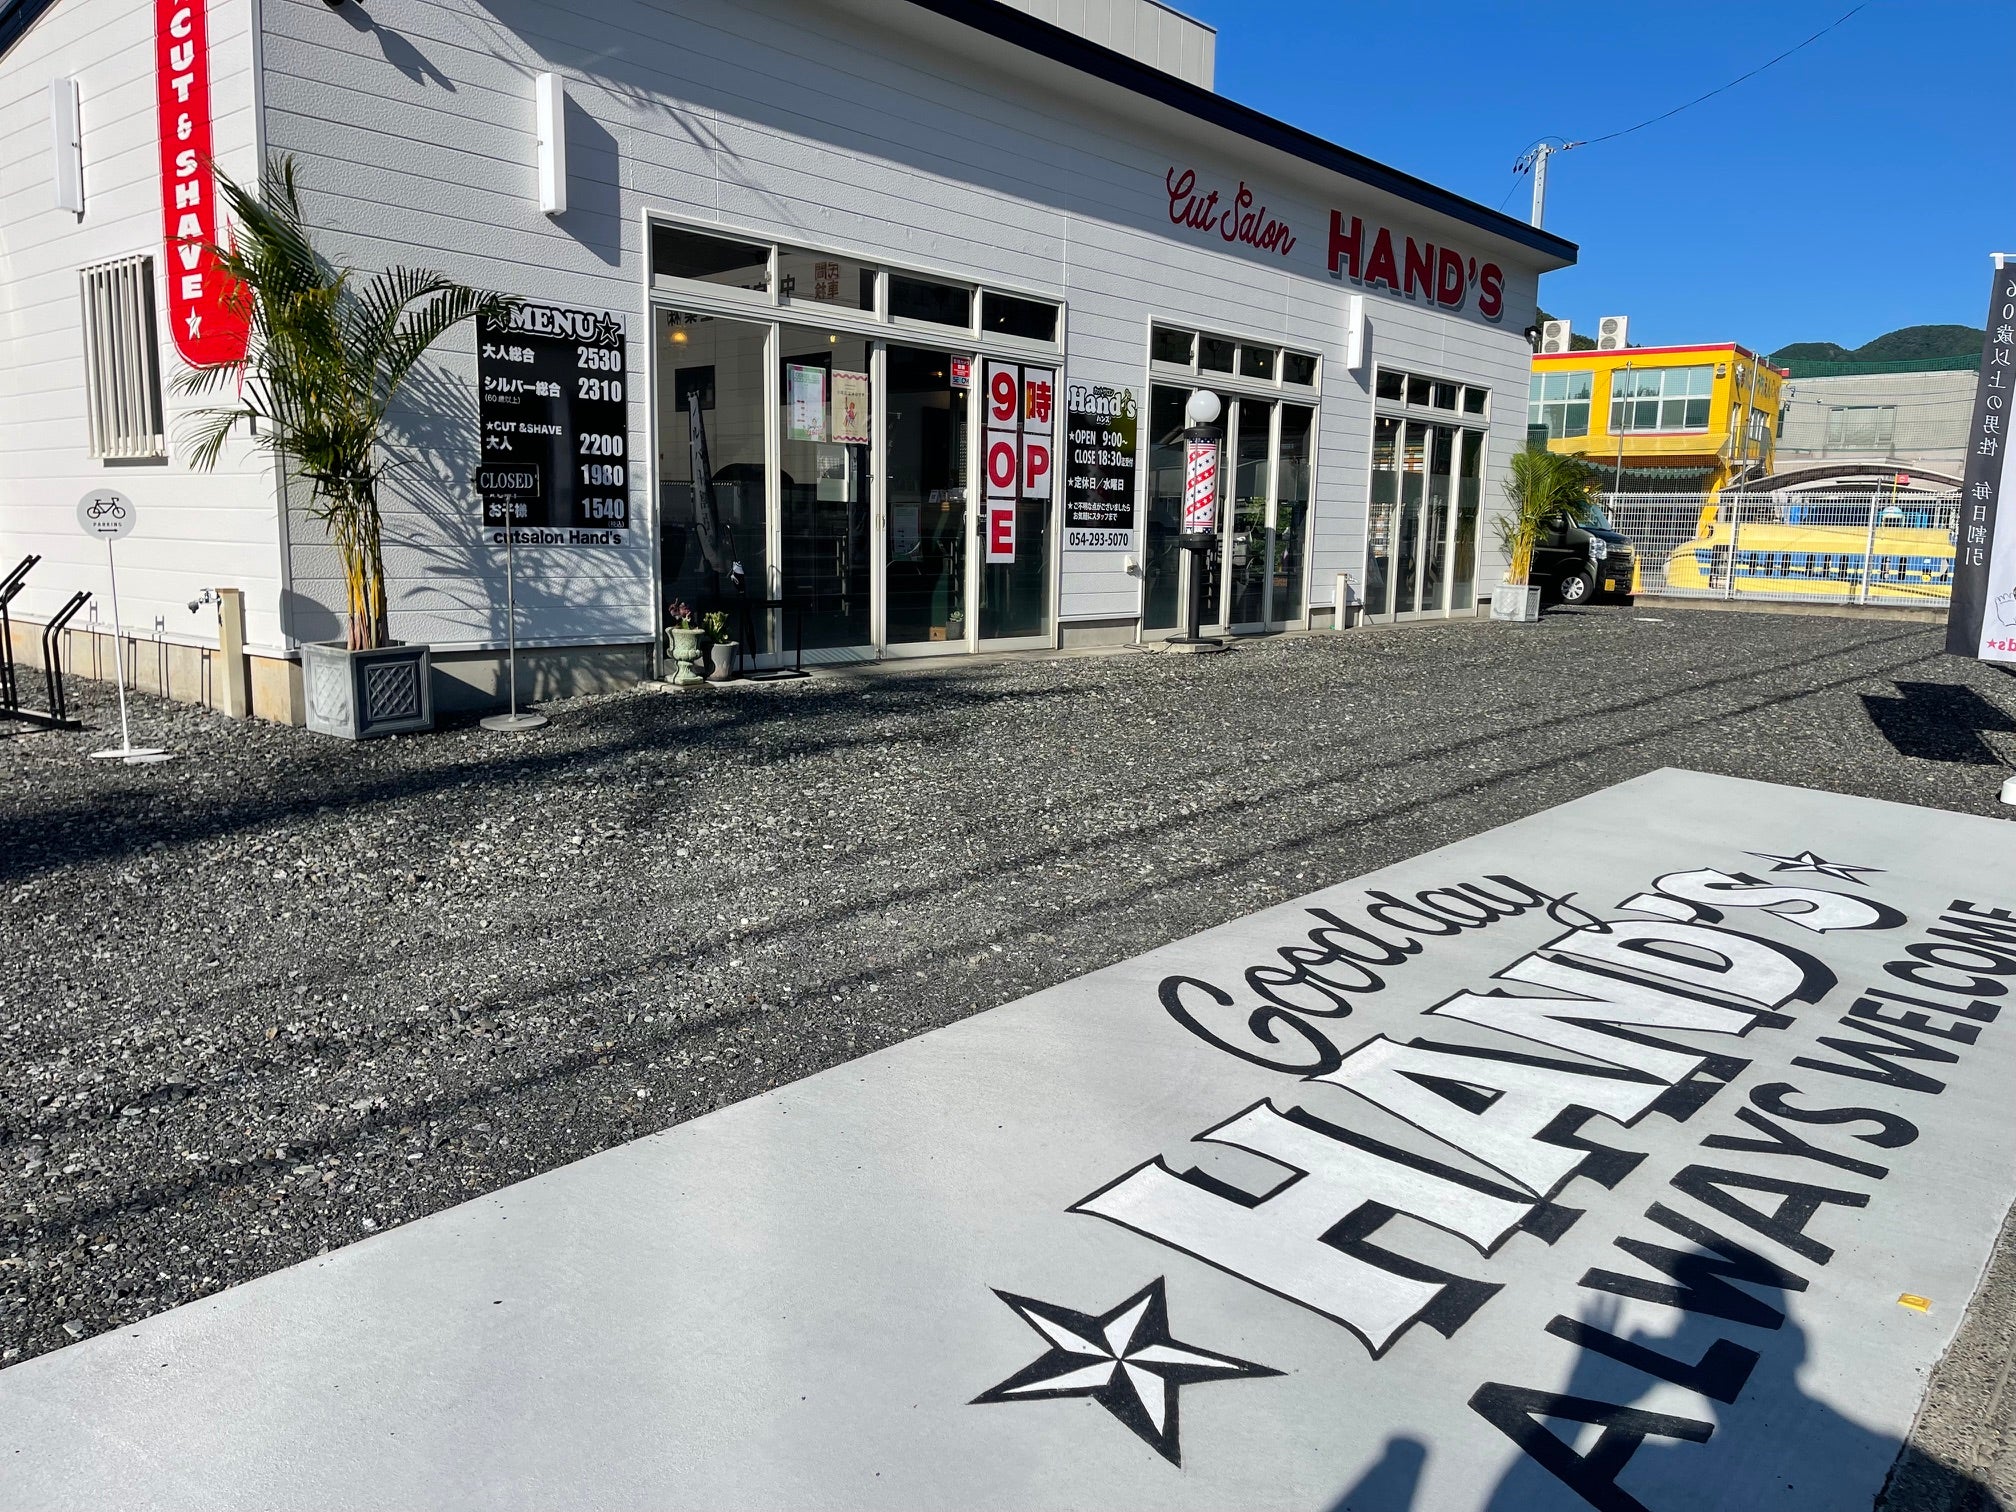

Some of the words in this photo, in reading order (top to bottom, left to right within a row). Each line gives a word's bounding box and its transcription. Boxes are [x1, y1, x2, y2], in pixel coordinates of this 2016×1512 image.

[169, 7, 195, 104] CUT
[176, 112, 193, 141] &
[174, 149, 205, 301] SHAVE
[1166, 166, 1219, 232] Cut
[1220, 181, 1297, 256] Salon
[1327, 208, 1504, 322] HAND'S
[508, 304, 597, 341] MENU
[482, 343, 535, 364] 大人総合
[577, 346, 622, 372] 2530
[484, 376, 562, 398] シルバー総合
[578, 377, 623, 403] 2310
[1069, 385, 1137, 419] Hand's
[486, 435, 513, 451] 大人
[579, 433, 624, 457] 2200
[1074, 429, 1097, 446] OPEN
[1074, 449, 1096, 465] CLOSE
[480, 472, 534, 489] CLOSED
[581, 464, 624, 486] 1980
[581, 498, 625, 519] 1540
[569, 530, 622, 544] Hand's
[1069, 532, 1129, 547] 054-293-5070
[1158, 908, 1423, 1076] Good
[1066, 867, 1908, 1361] HAND'S
[1467, 1082, 1920, 1512] ALWAYS
[1790, 899, 2016, 1095] WELCOME
